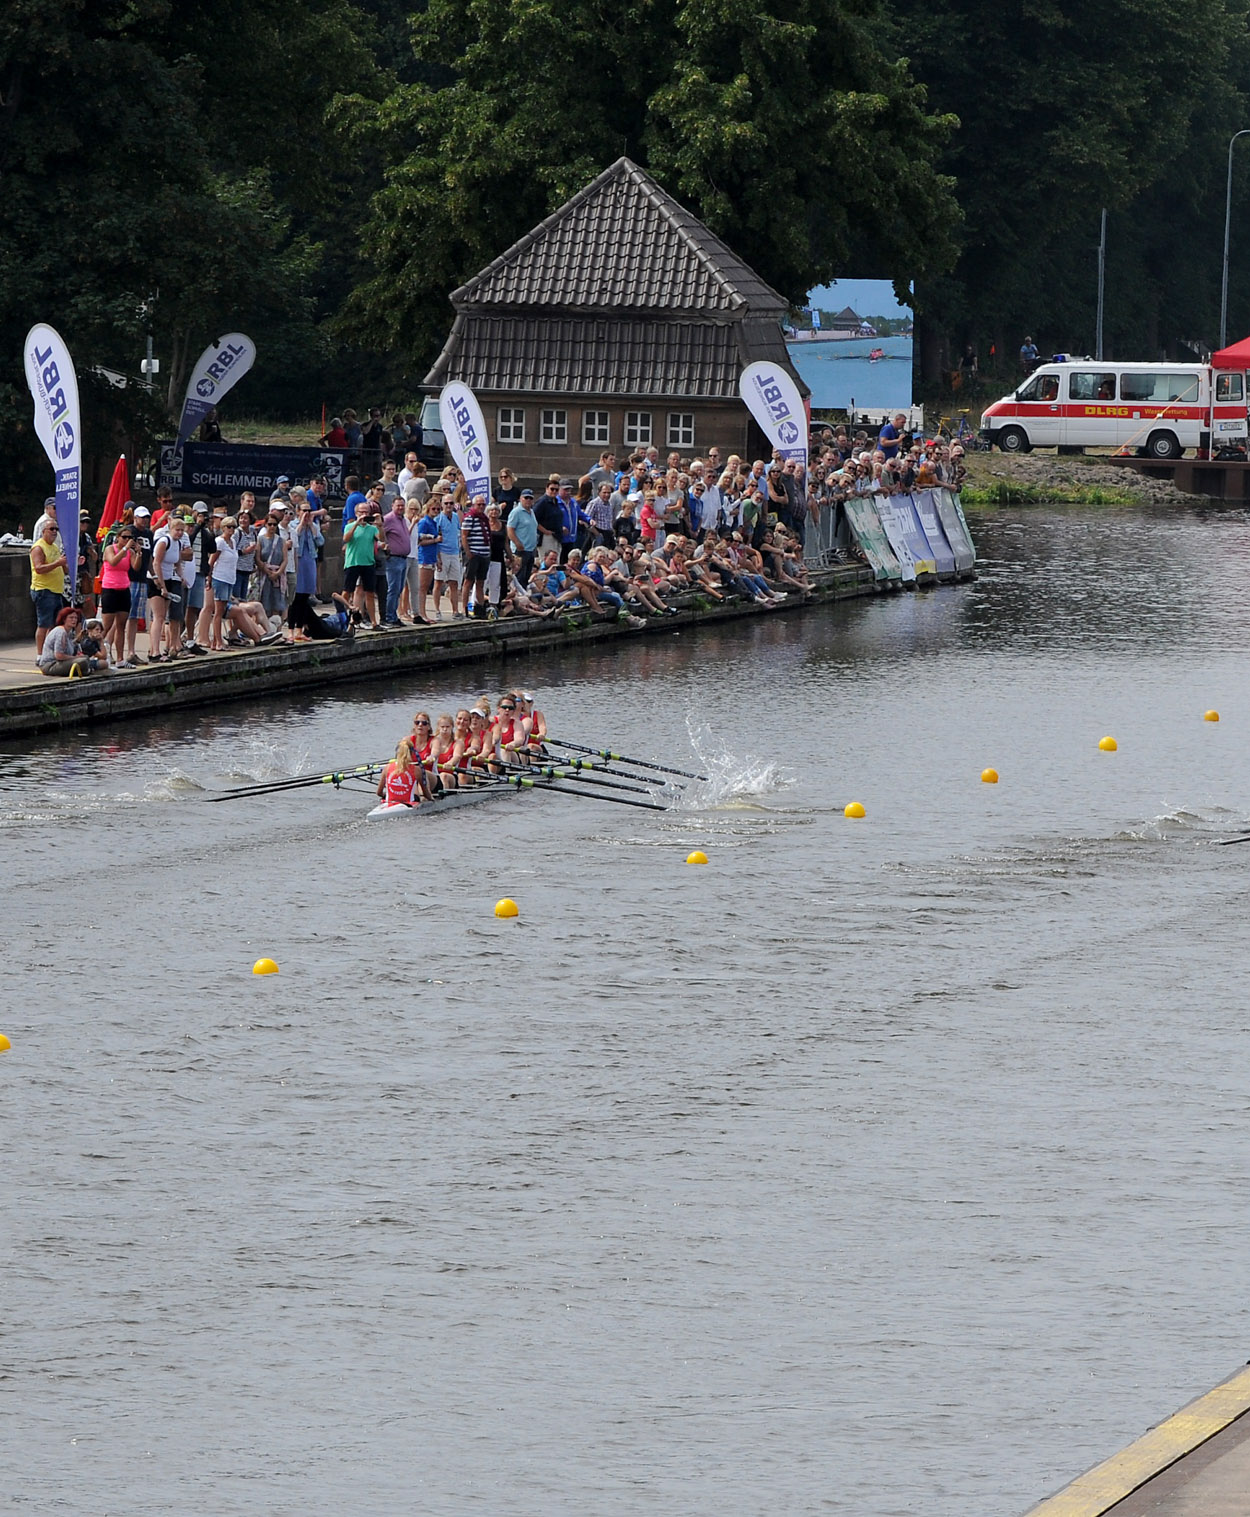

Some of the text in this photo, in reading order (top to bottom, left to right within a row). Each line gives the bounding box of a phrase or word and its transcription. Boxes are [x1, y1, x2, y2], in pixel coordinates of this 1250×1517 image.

[206, 343, 244, 379] RBL
[1085, 406, 1129, 416] DLRG
[161, 475, 182, 485] RBL
